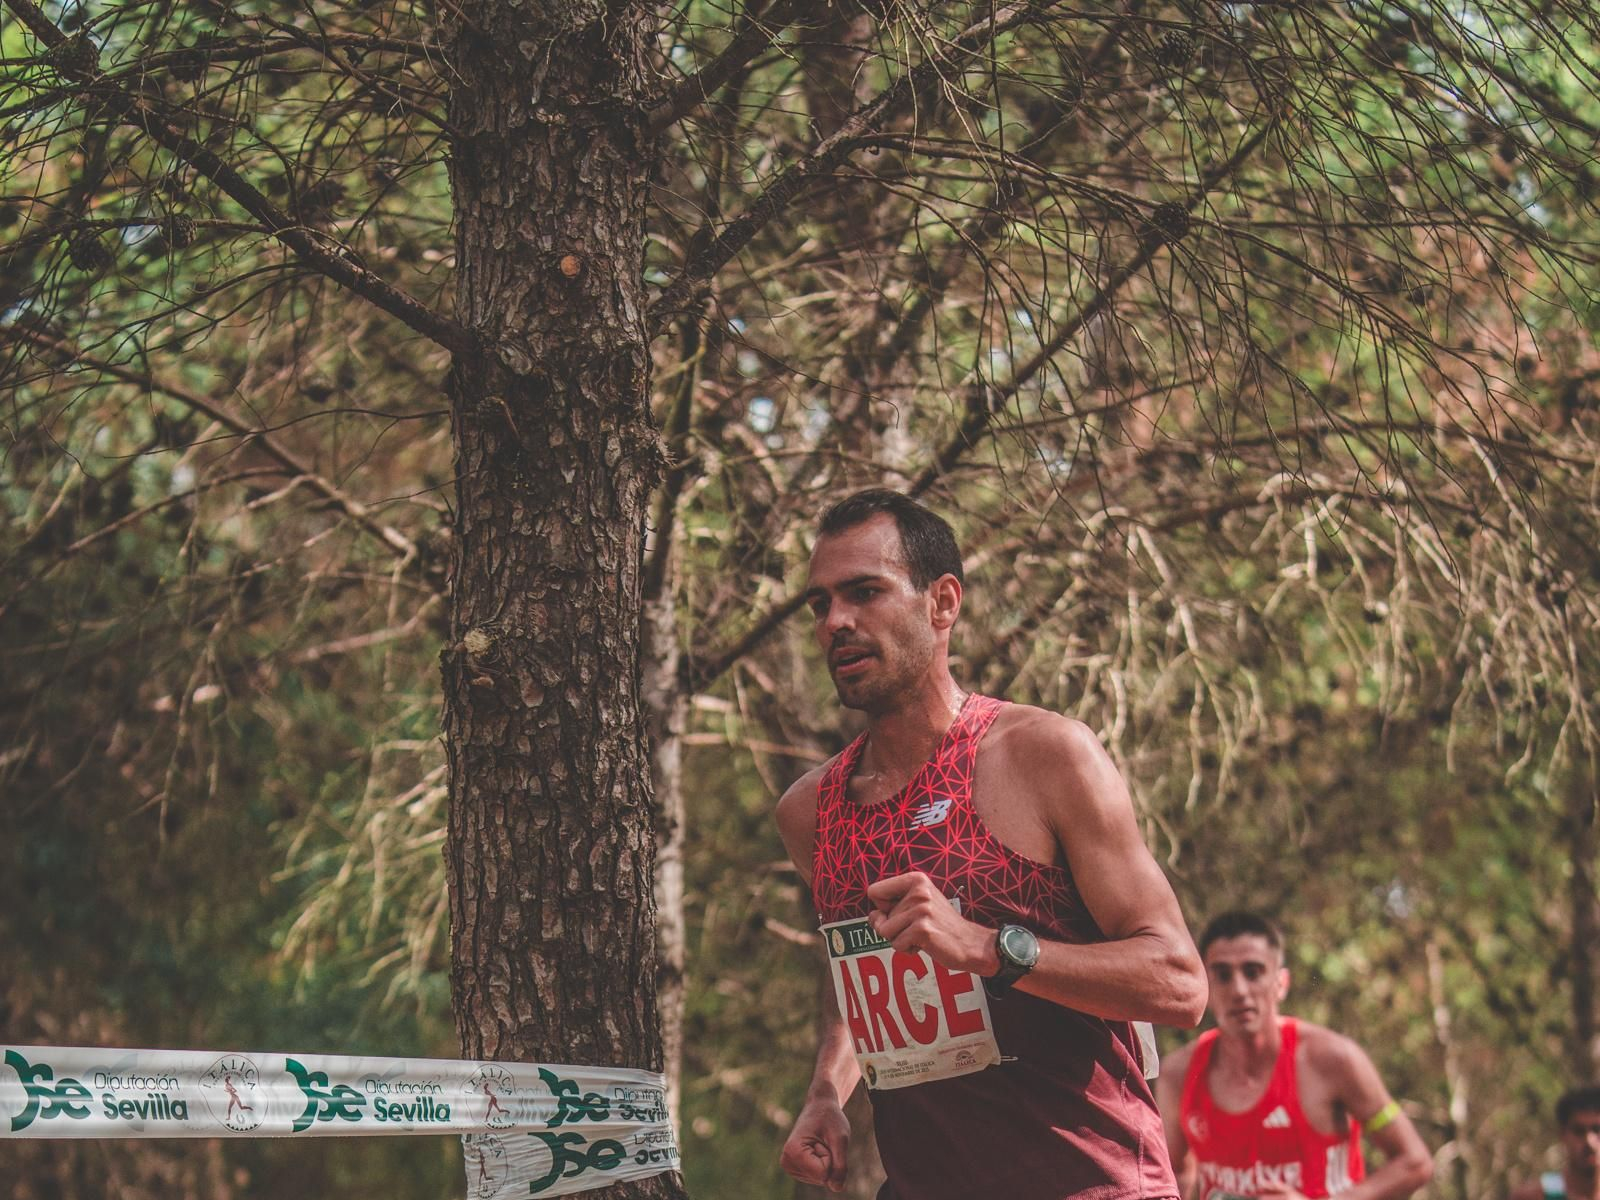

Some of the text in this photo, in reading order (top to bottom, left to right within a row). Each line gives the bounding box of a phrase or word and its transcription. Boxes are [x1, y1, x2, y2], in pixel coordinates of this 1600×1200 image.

[839, 950, 986, 1055] ARCE
[94, 1072, 180, 1091] Diputación
[103, 1093, 189, 1120] Sevilla
[374, 1098, 450, 1122] Sevilla
